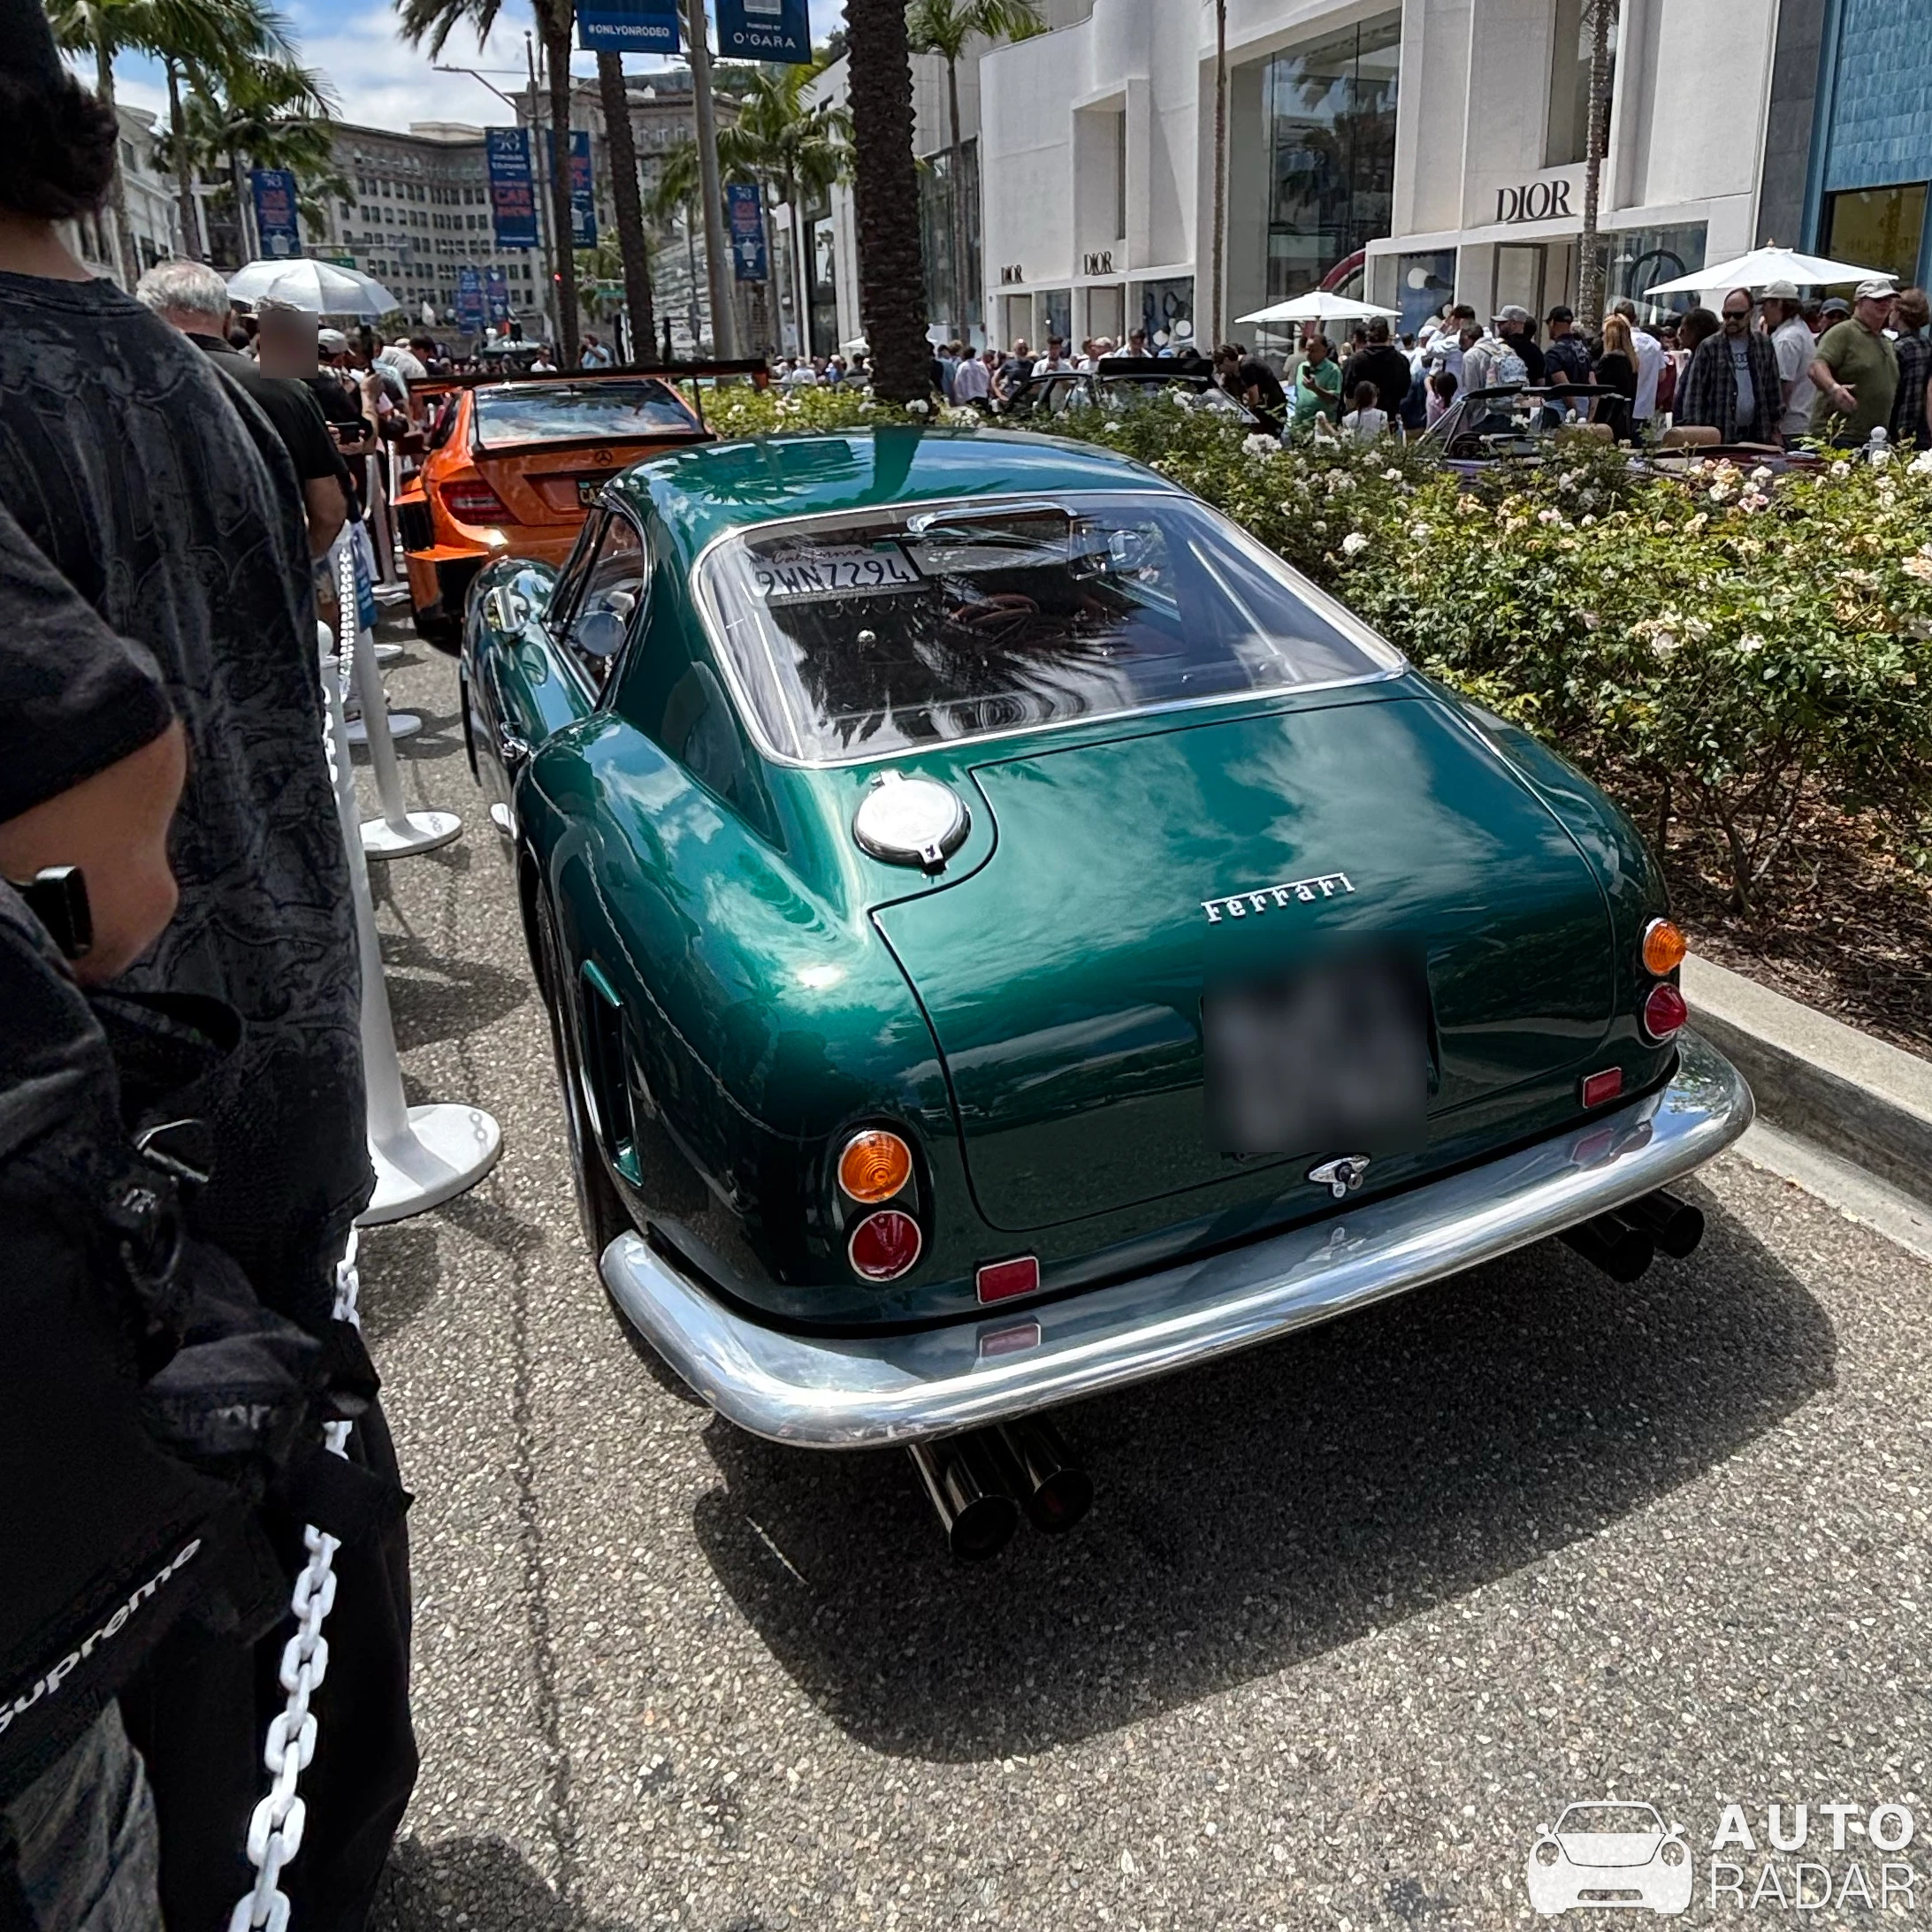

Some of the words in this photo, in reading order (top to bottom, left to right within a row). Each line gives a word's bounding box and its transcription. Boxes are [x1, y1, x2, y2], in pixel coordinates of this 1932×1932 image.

[588, 24, 669, 37] #ONLYONRODEO
[733, 32, 796, 49] O'GARA
[1494, 179, 1571, 222] DIOR
[1000, 263, 1024, 286] DIOR
[1083, 251, 1113, 275] DIOR
[1201, 873, 1355, 922] Ferrari
